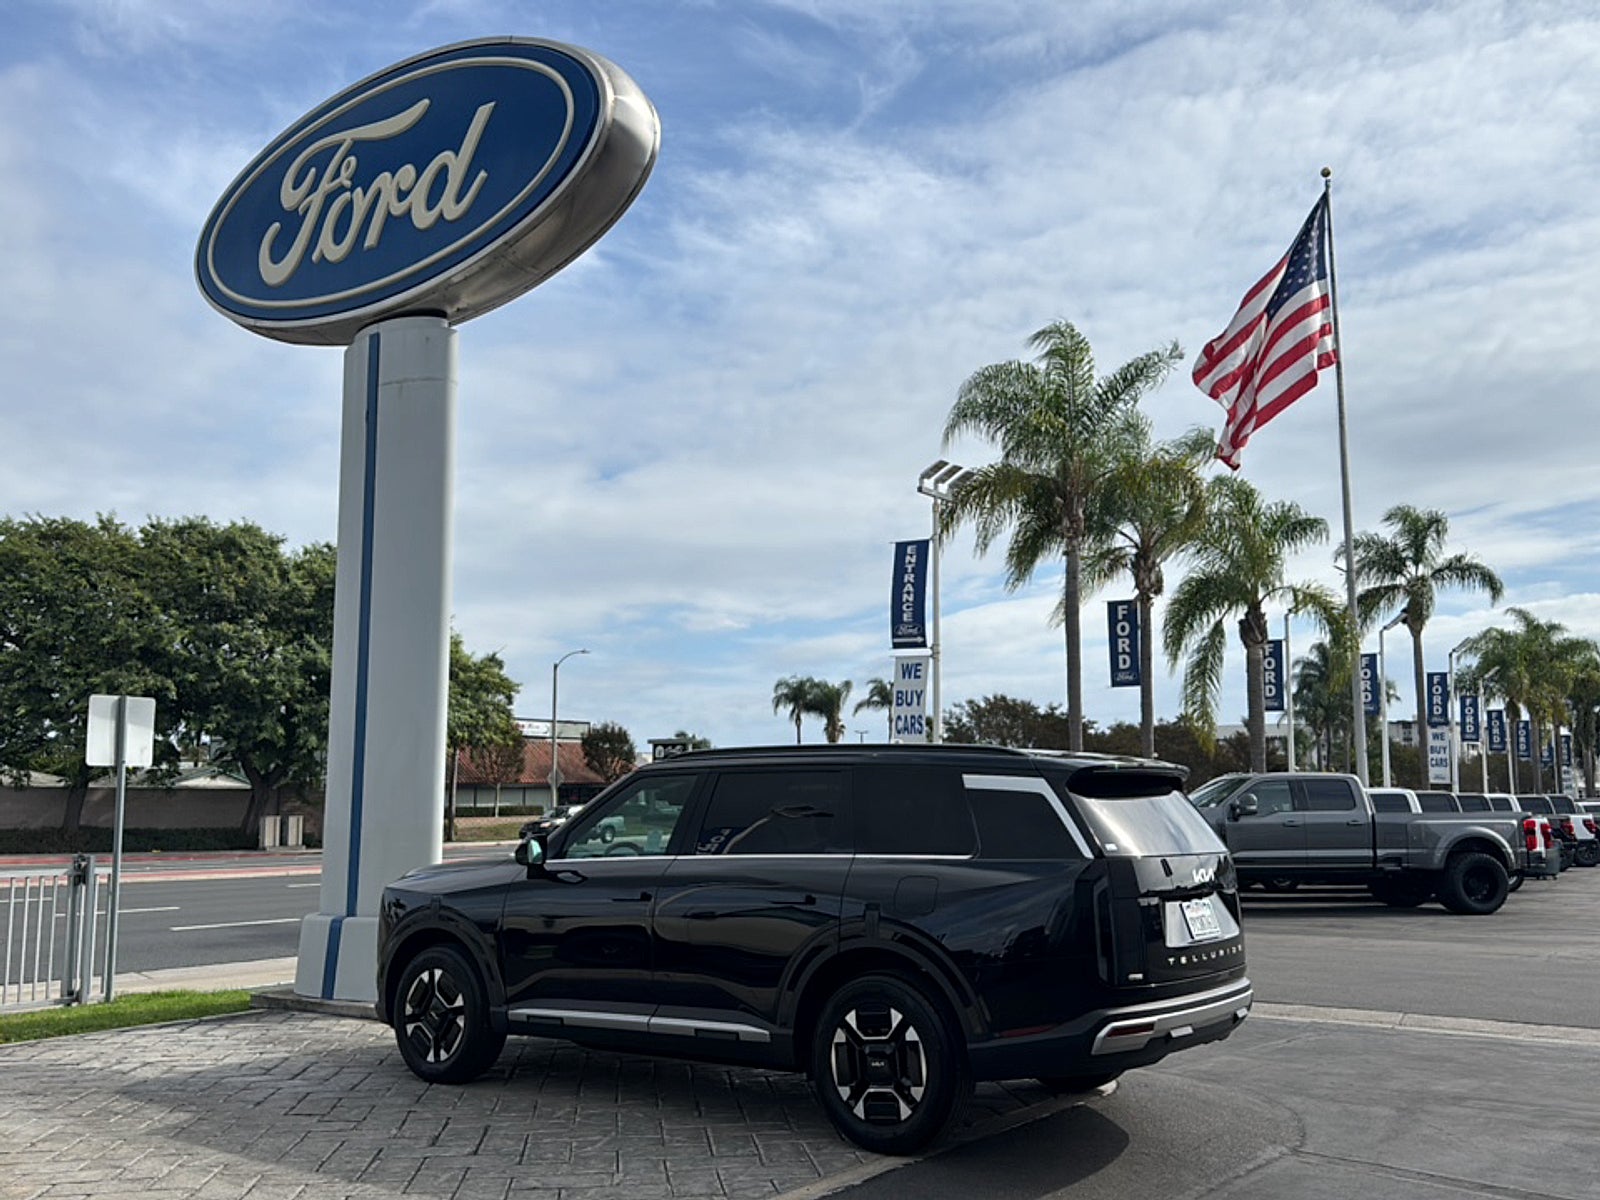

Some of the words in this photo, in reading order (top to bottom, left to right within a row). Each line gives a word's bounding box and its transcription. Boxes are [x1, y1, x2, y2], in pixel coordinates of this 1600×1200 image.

[258, 98, 496, 286] Ford
[902, 545, 917, 622] ENTRANCE
[1116, 605, 1131, 670] FORD
[901, 663, 923, 680] WE
[1263, 644, 1276, 697] FORD
[1361, 657, 1372, 703] FORD
[896, 690, 923, 707] BUY
[1432, 675, 1442, 715] FORD
[895, 715, 924, 735] CARS
[1465, 699, 1474, 733] FORD
[1491, 712, 1500, 743] FORD
[1430, 745, 1447, 755] BUY
[1432, 732, 1446, 741] WE
[1430, 758, 1448, 768] CARS
[1192, 868, 1215, 883] KIA
